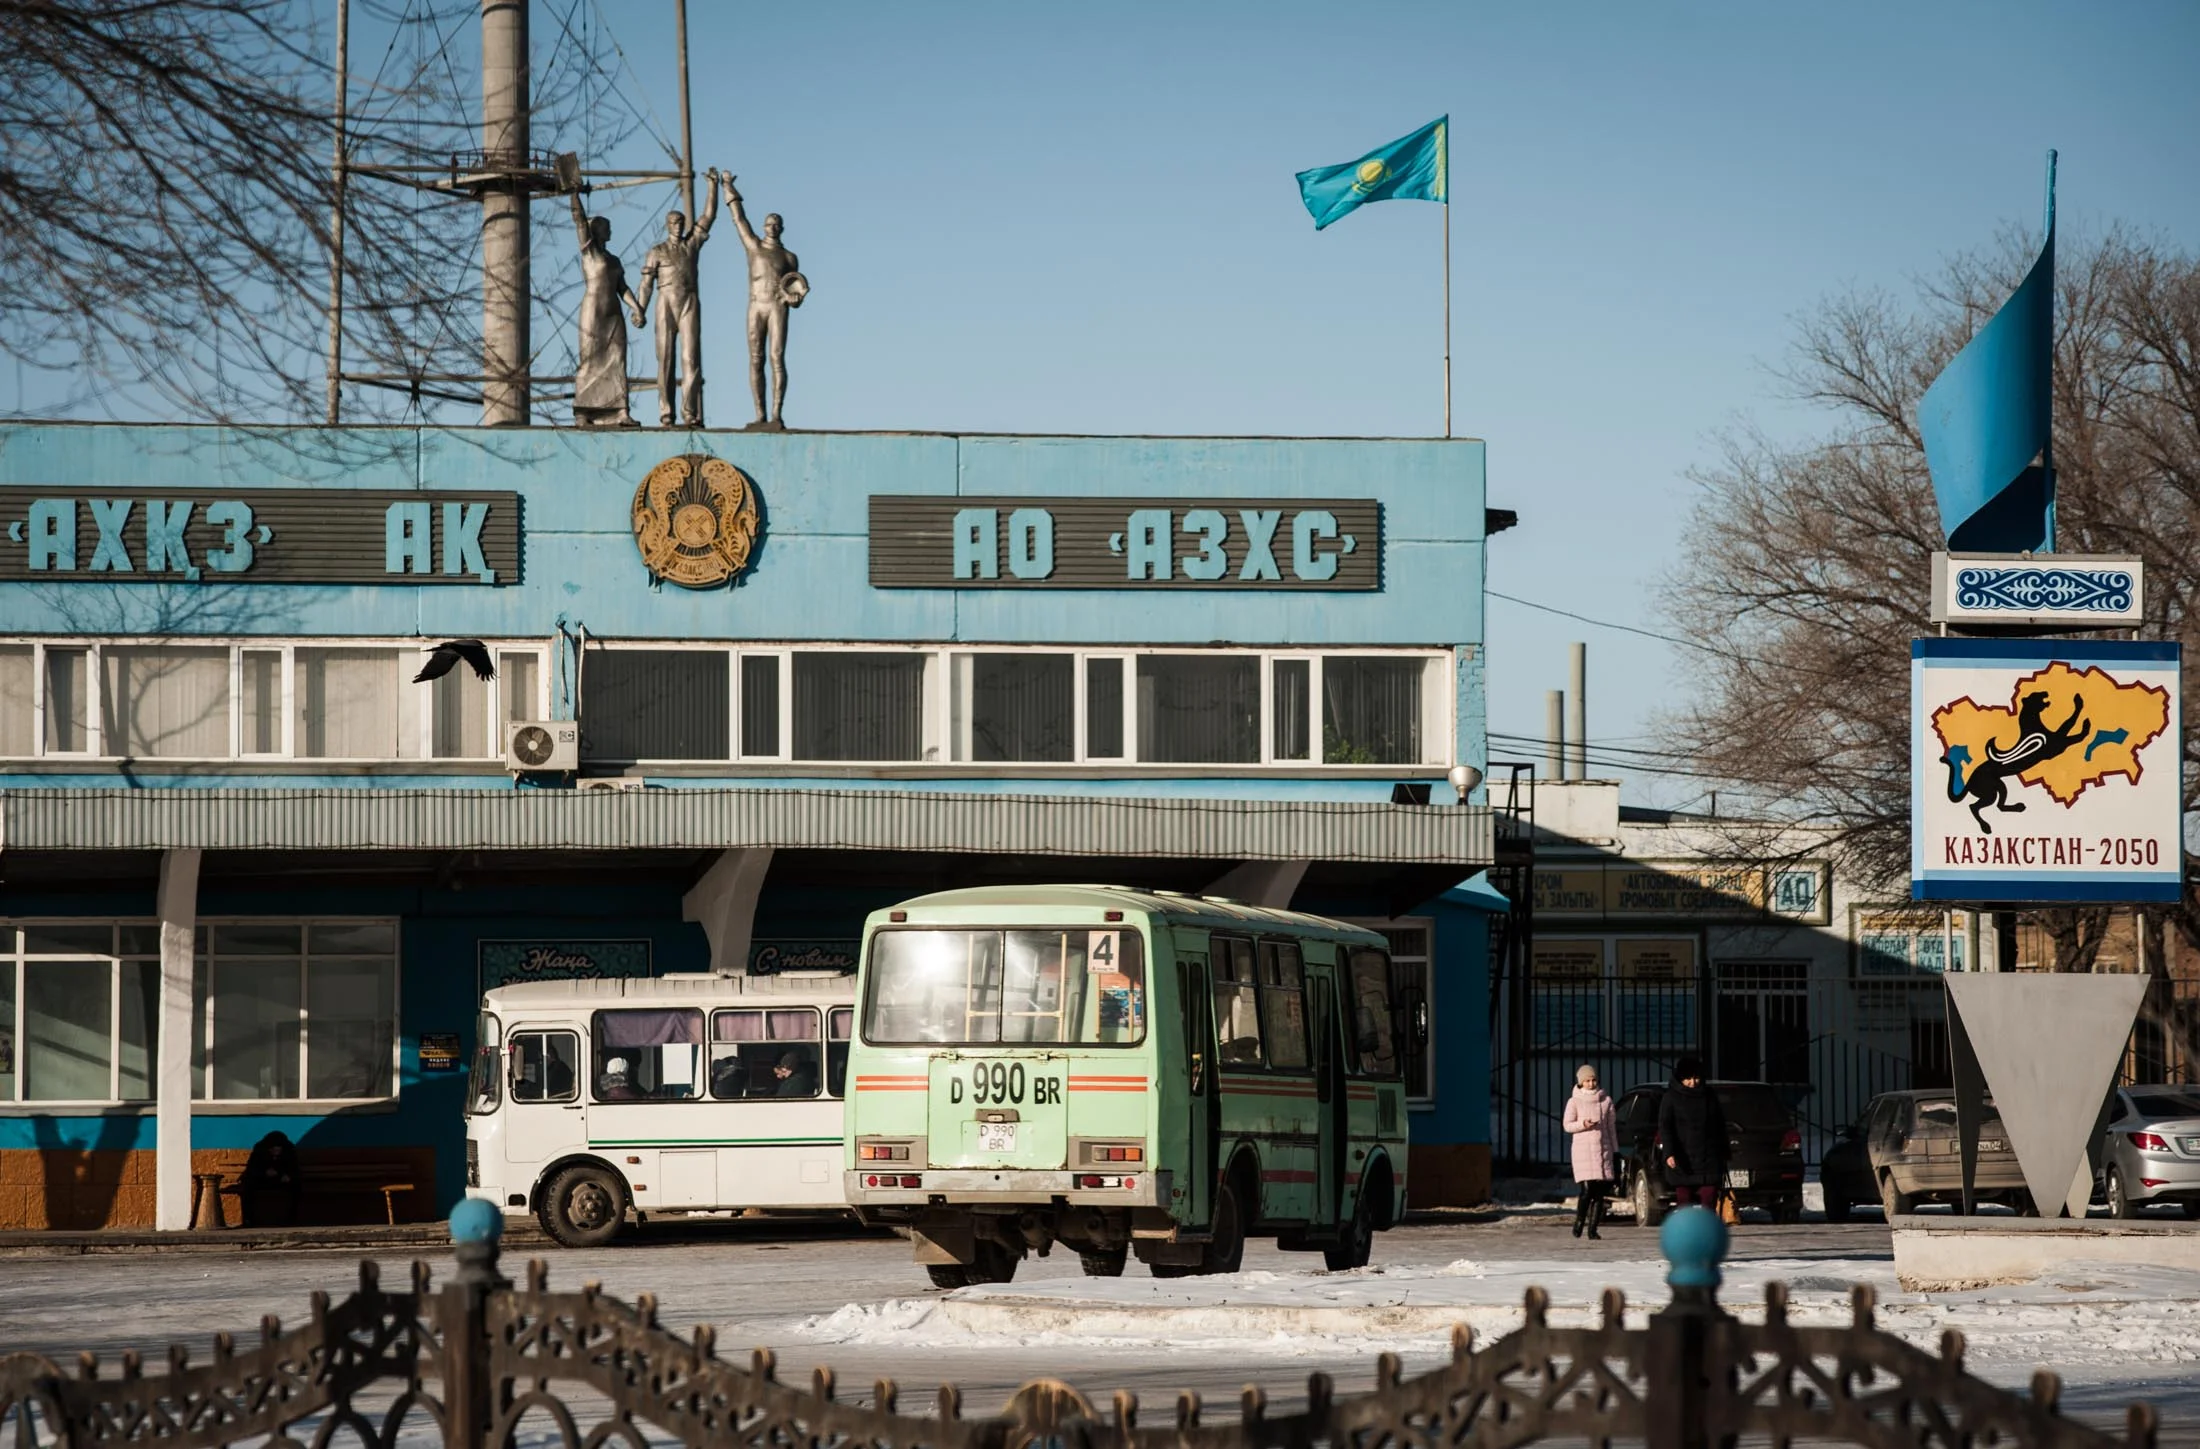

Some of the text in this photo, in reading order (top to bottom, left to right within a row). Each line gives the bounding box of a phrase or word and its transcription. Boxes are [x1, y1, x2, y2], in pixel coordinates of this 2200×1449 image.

[385, 502, 495, 583] АҚ
[953, 508, 1053, 579] АО
[1944, 836, 2160, 866] ҚАЗАҚСТАН-2050
[520, 948, 596, 973] Жаңа
[755, 945, 855, 973] С новым
[1093, 934, 1114, 966] 4
[1923, 940, 1958, 954] ОТДЛ
[950, 1061, 1061, 1104] D 990 BR
[980, 1125, 1015, 1137] D 990
[988, 1139, 1005, 1150] BR
